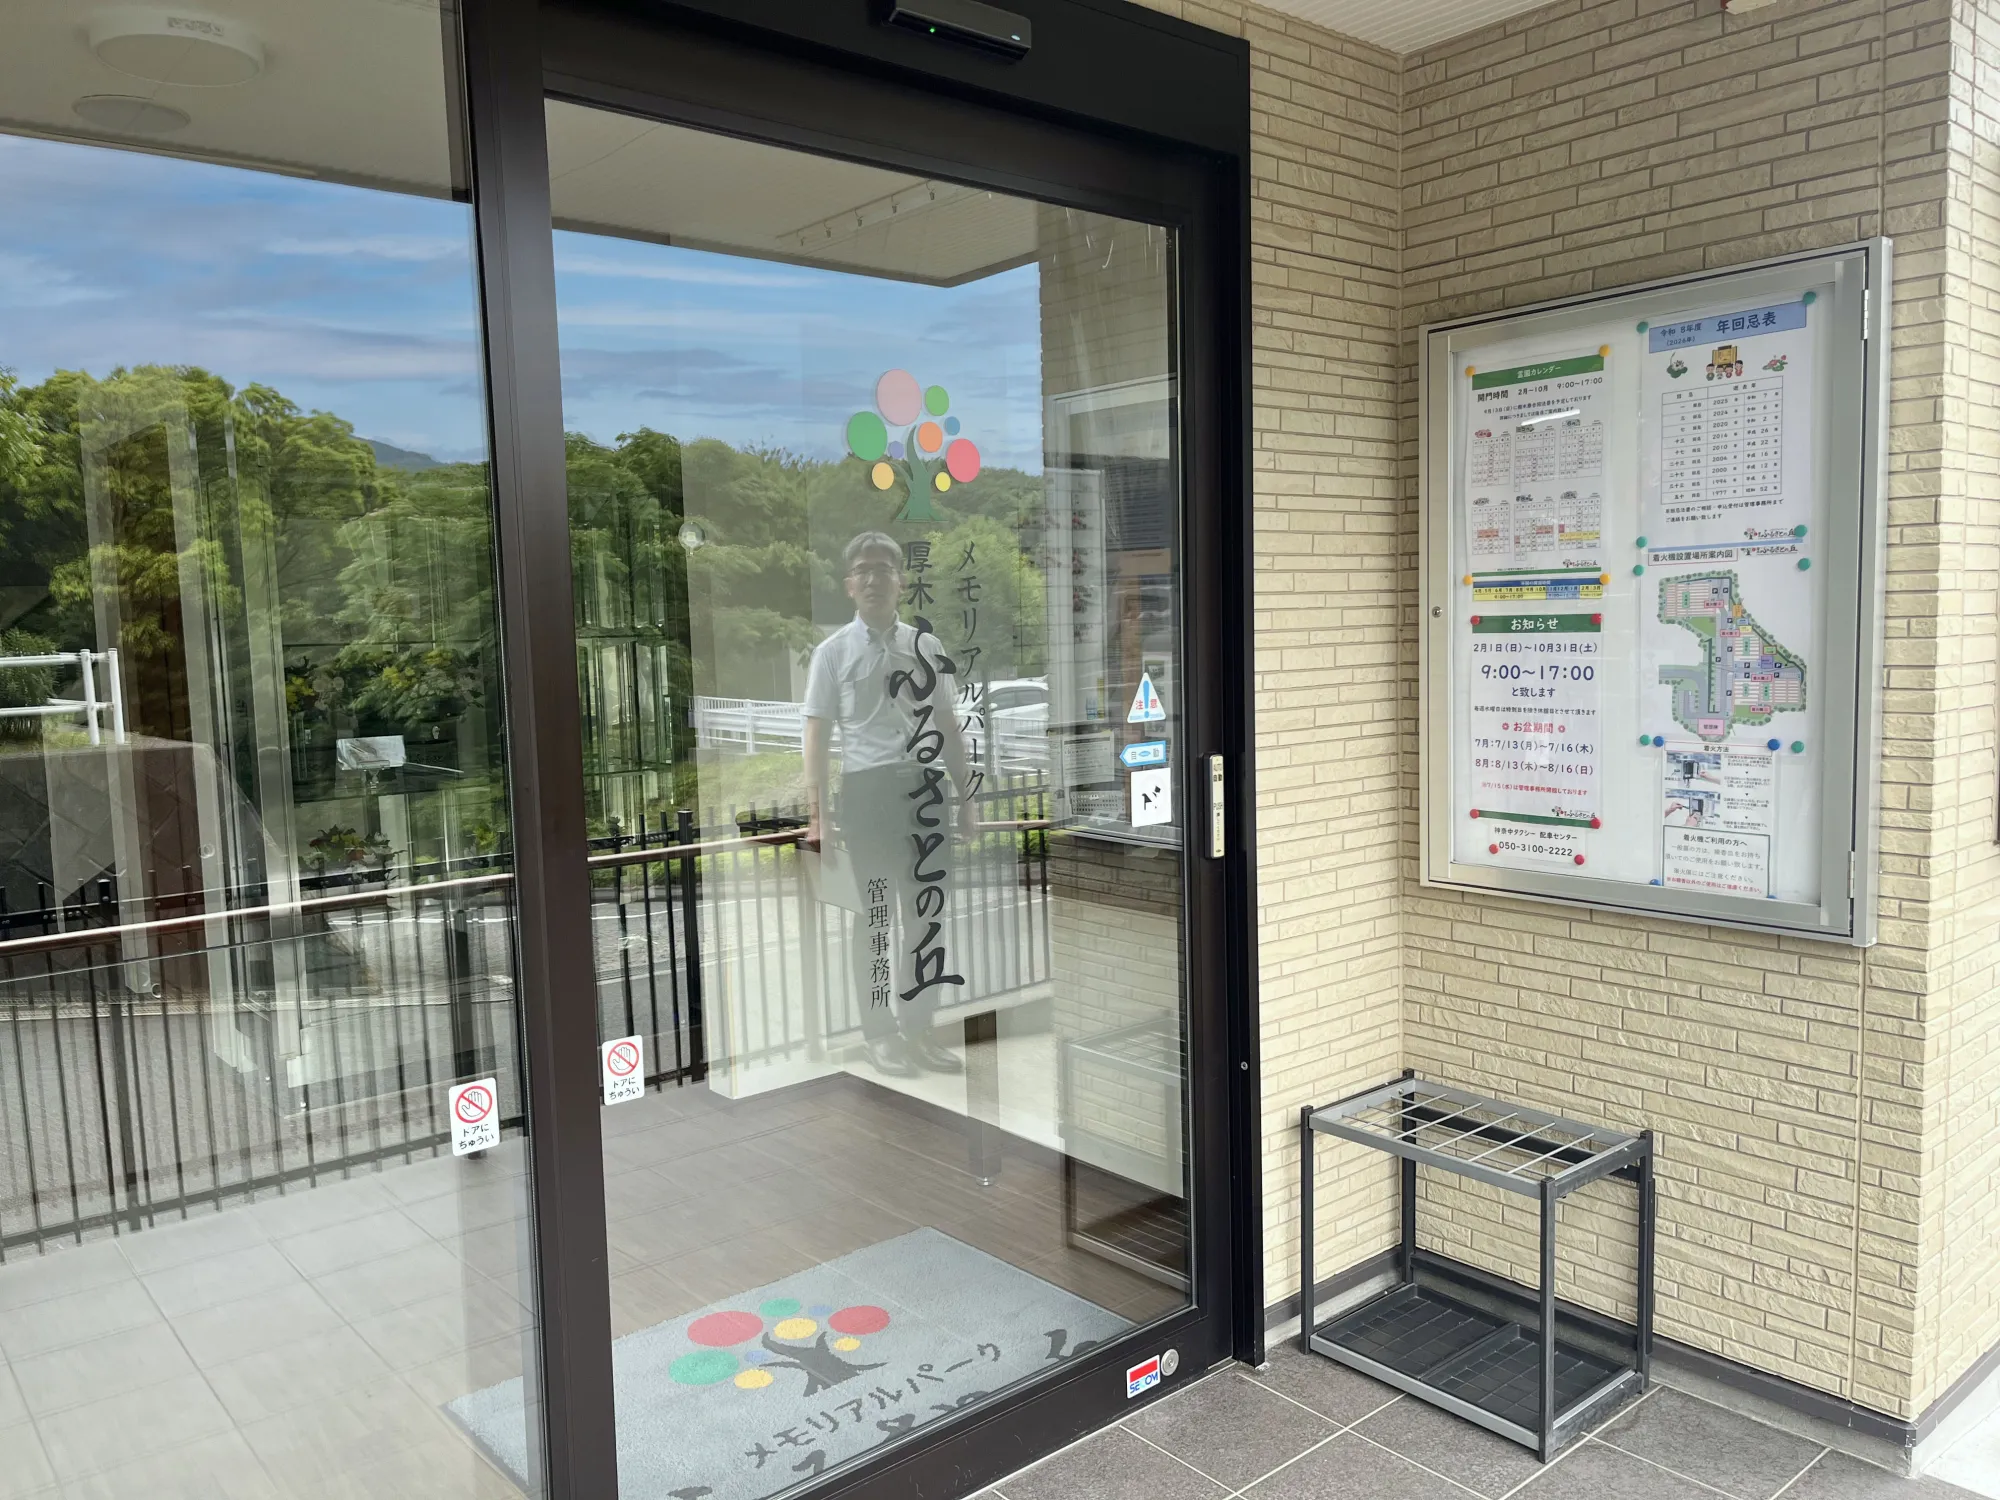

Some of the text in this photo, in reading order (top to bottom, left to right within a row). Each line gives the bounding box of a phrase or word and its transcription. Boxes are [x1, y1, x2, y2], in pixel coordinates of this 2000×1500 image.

[1716, 311, 1777, 334] 年回忌表
[1666, 336, 1696, 347] (2026年)
[1477, 390, 1509, 403] 開門時間
[1652, 549, 1733, 562] 着火機設置場所案内図
[1511, 617, 1559, 631] お知らせ
[957, 541, 985, 801] メモリアルパーク
[1481, 665, 1594, 681] 9:00～17:00
[1511, 687, 1556, 698] と致します
[1513, 722, 1554, 734] お盆期間
[1703, 745, 1729, 753] 着火方法
[1494, 826, 1578, 840] 神奈中タクシー 配車センター
[1683, 833, 1748, 847] 着火機ご利用の方へ
[1498, 841, 1573, 857] 050-3100-2222
[867, 877, 891, 1010] 管理事務所
[608, 1086, 640, 1100] ちゅうい
[458, 1133, 495, 1150] ちゅうい
[744, 1342, 1000, 1469] メモリアルパーク
